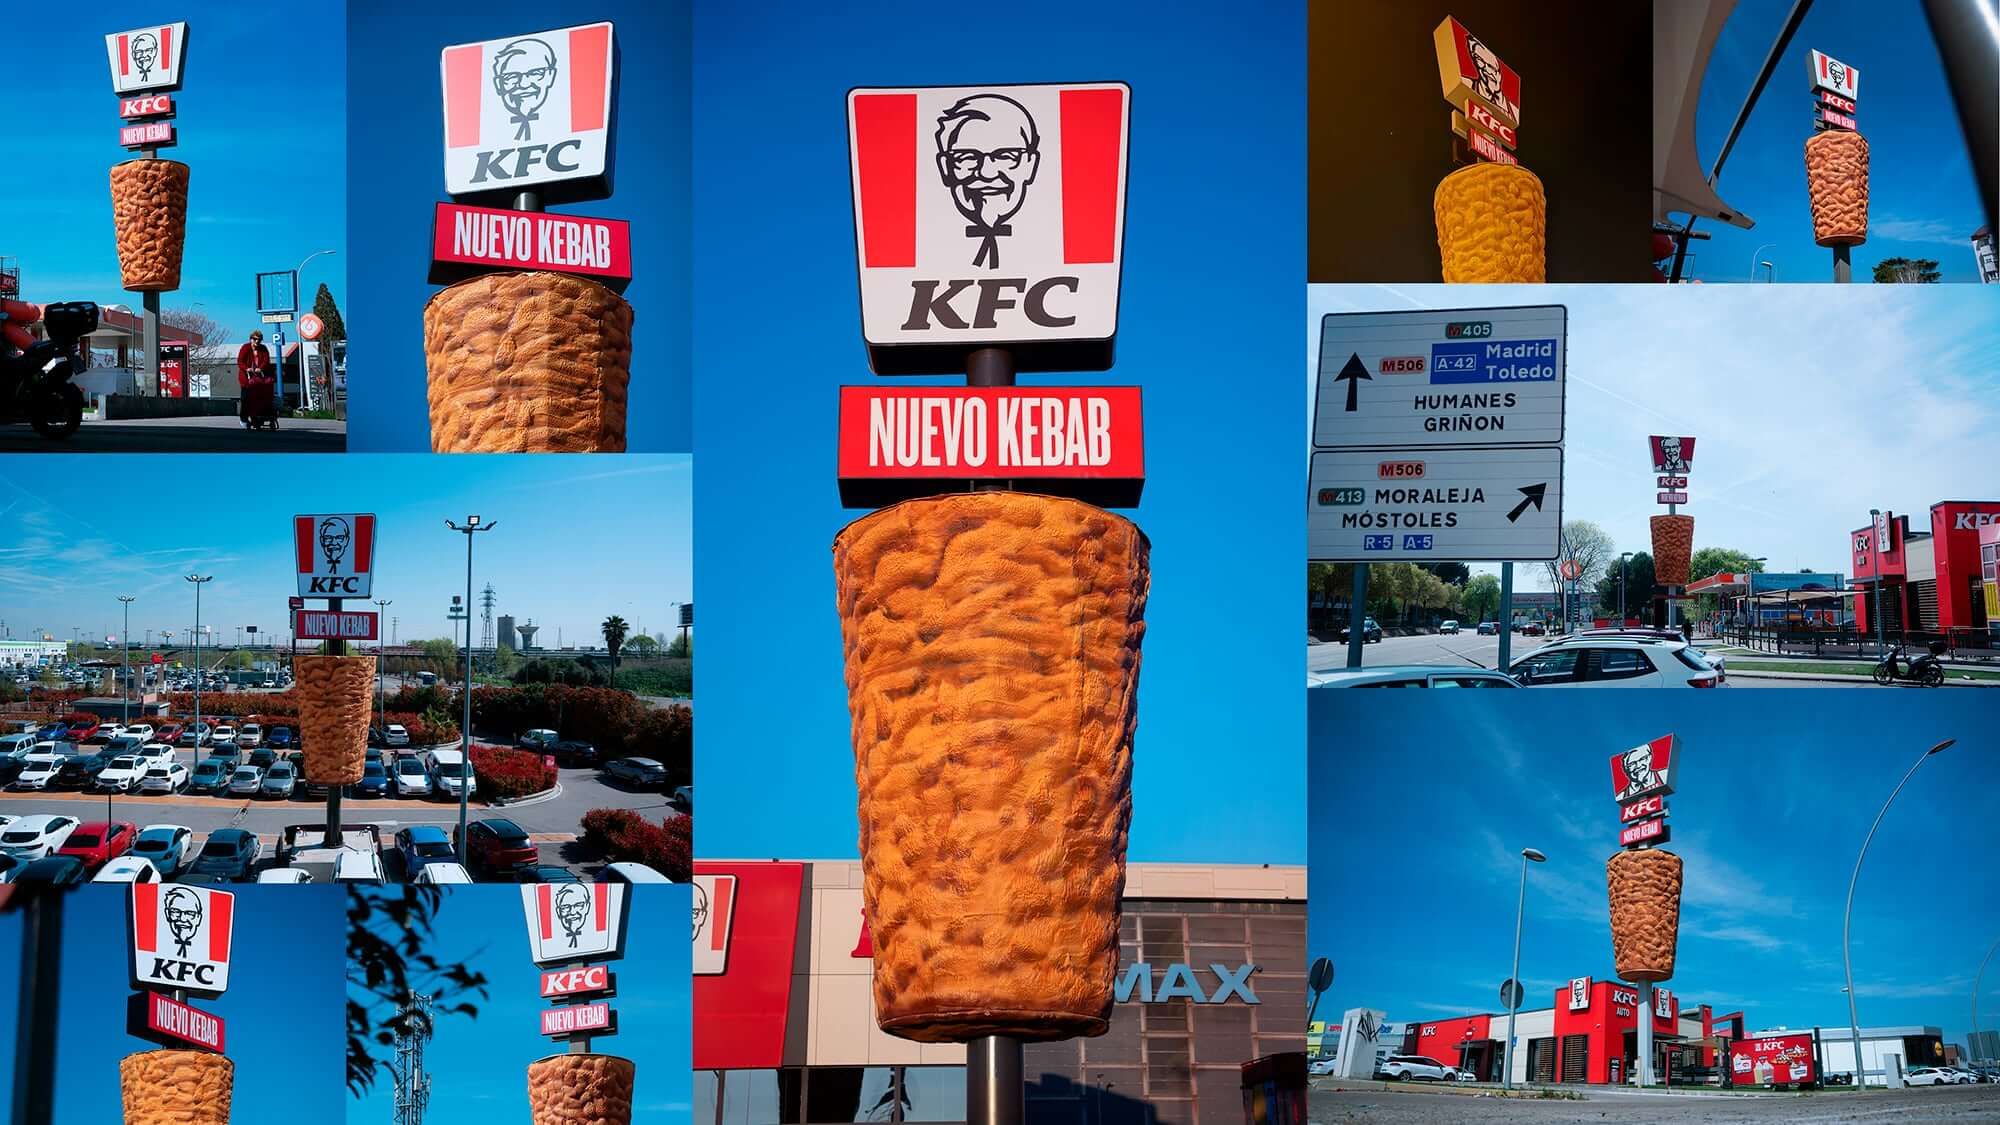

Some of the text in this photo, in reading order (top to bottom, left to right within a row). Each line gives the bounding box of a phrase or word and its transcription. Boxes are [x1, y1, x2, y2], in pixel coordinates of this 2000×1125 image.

[122, 95, 168, 116] KFC
[1825, 93, 1855, 113] KFC
[1472, 104, 1512, 142] KFC
[123, 127, 145, 144] NUEVO
[1474, 132, 1497, 161] NUEVO
[469, 139, 582, 184] KFC
[454, 211, 611, 269] NUEVO KEBAB
[900, 276, 1080, 331] KFC
[272, 333, 281, 344] P
[1449, 324, 1491, 336] M405
[1486, 343, 1552, 359] Madrid
[1382, 359, 1425, 372] M506
[1438, 357, 1475, 370] A-42
[1486, 365, 1554, 380] Toledo
[1414, 393, 1517, 410] HUMANES
[869, 396, 1112, 467] NUEVO KEBAB
[1424, 414, 1505, 432] GRIÑON
[1380, 464, 1423, 476] M506
[1661, 477, 1686, 486] KFC
[1321, 487, 1486, 504] M413 MORALEJA
[1341, 511, 1458, 529] MÓSTOLES
[1365, 537, 1432, 549] R-5 A-5
[1855, 535, 1869, 553] KFC
[308, 576, 360, 593] KFC
[305, 613, 370, 637] NUEVO KEBAB
[1623, 797, 1659, 820] KFC
[150, 957, 215, 985] KFC
[543, 967, 604, 995] KFC
[1613, 990, 1637, 1006] KFC
[545, 1005, 605, 1033] NUEVO KEBAB
[1616, 1007, 1630, 1017] AUTO
[156, 998, 218, 1046] NUEVO KEBAB
[1422, 1026, 1436, 1037] KFC
[1763, 1041, 1785, 1052] KFC
